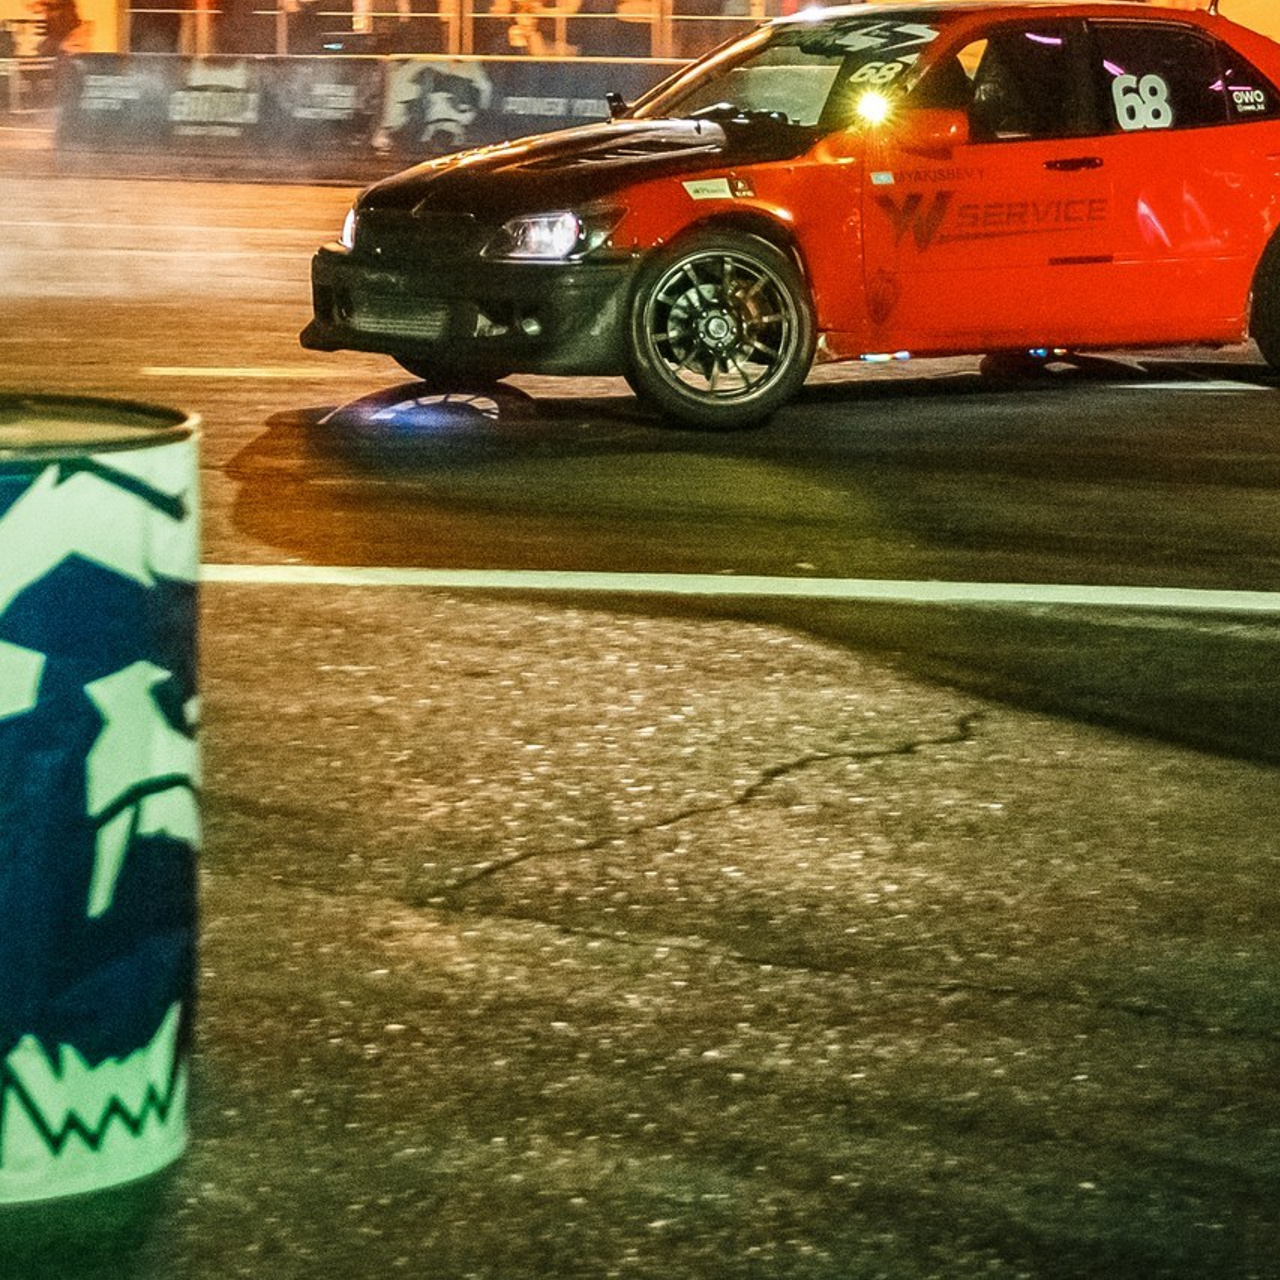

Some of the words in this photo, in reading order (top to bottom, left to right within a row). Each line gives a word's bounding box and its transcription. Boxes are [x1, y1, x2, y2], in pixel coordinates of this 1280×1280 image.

[848, 61, 904, 84] 68
[1111, 74, 1173, 131] 68
[1232, 90, 1265, 104] OWO
[957, 198, 1109, 227] SERVICE
